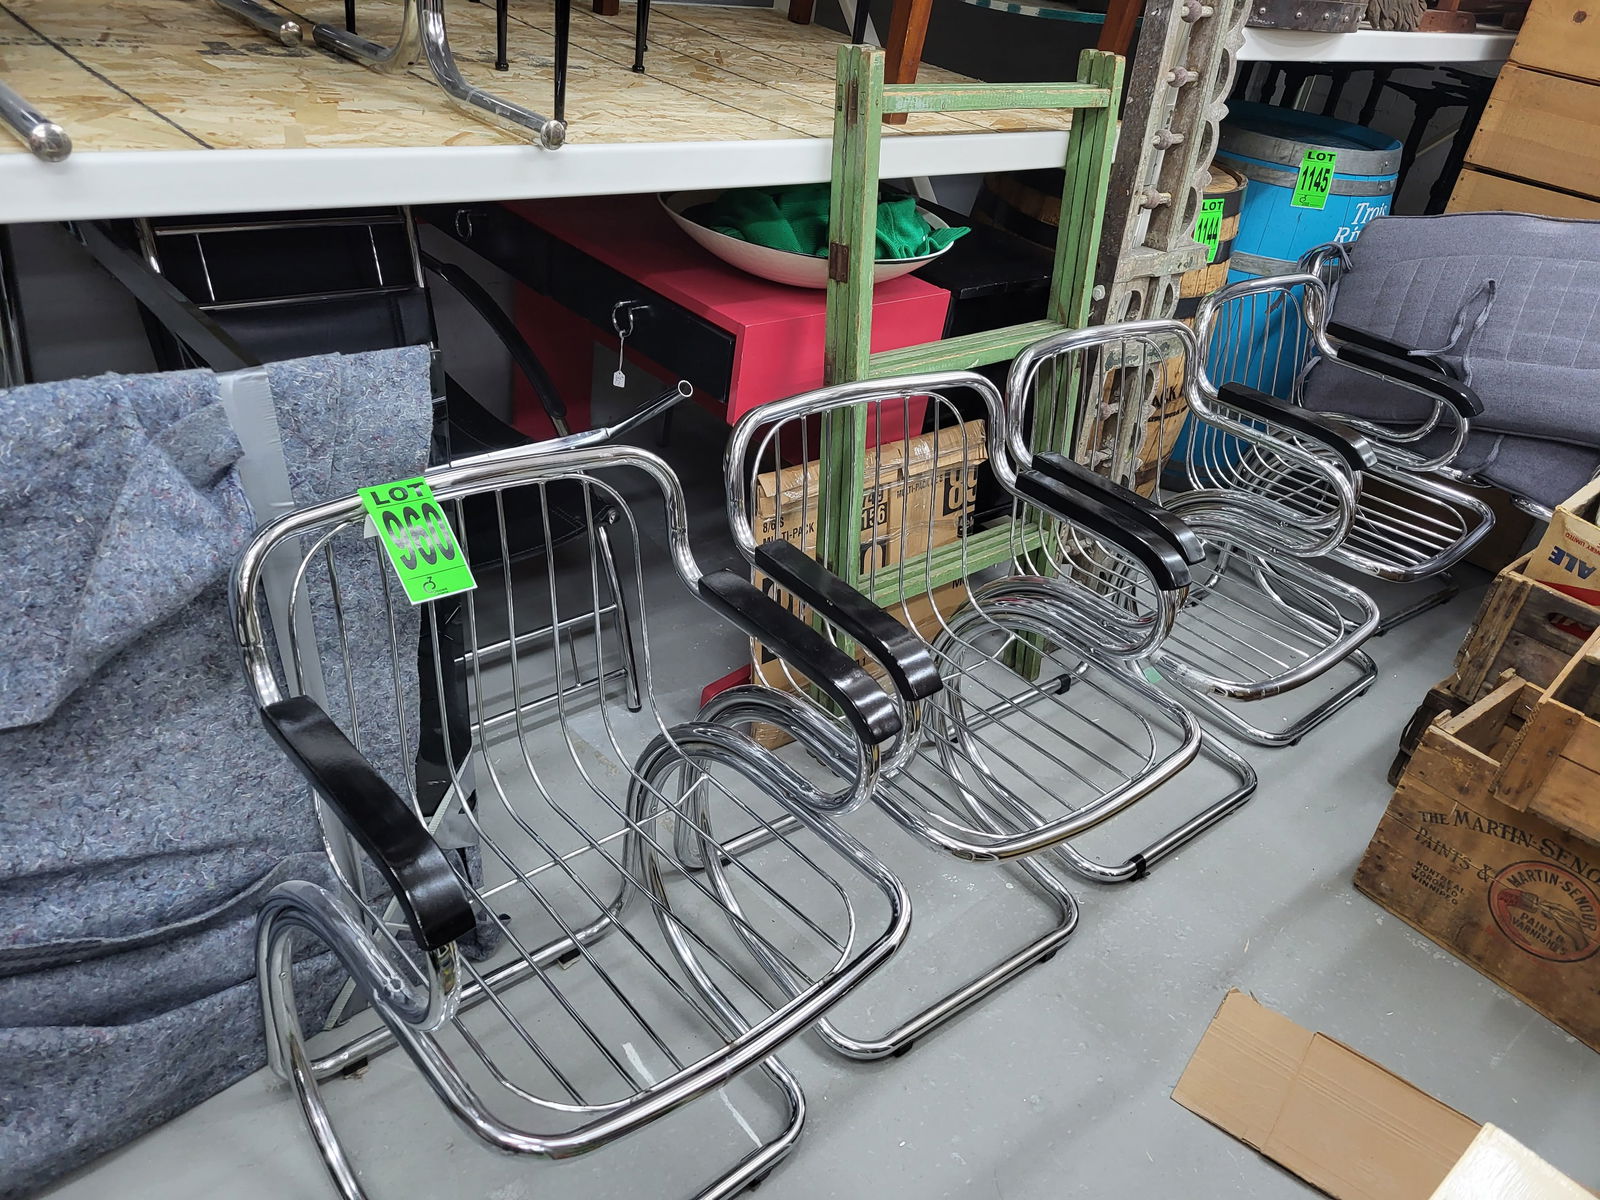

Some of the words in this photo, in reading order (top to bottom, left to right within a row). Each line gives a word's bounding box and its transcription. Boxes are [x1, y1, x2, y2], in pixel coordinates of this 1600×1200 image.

[1307, 151, 1336, 162] LOT
[1301, 166, 1331, 193] 1145
[1202, 201, 1223, 211] LOT
[1197, 217, 1219, 242] 1144
[370, 482, 424, 505] LOT
[382, 502, 456, 571] 960
[1547, 545, 1597, 579] ALE
[1418, 810, 1450, 825] THE
[1414, 826, 1472, 870] PAINTS
[1411, 866, 1458, 897] TORONTO
[1411, 872, 1458, 905] WINNIPEG
[1416, 861, 1465, 895] MONTREAL
[1506, 869, 1597, 932] MARTIN-SENOUR
